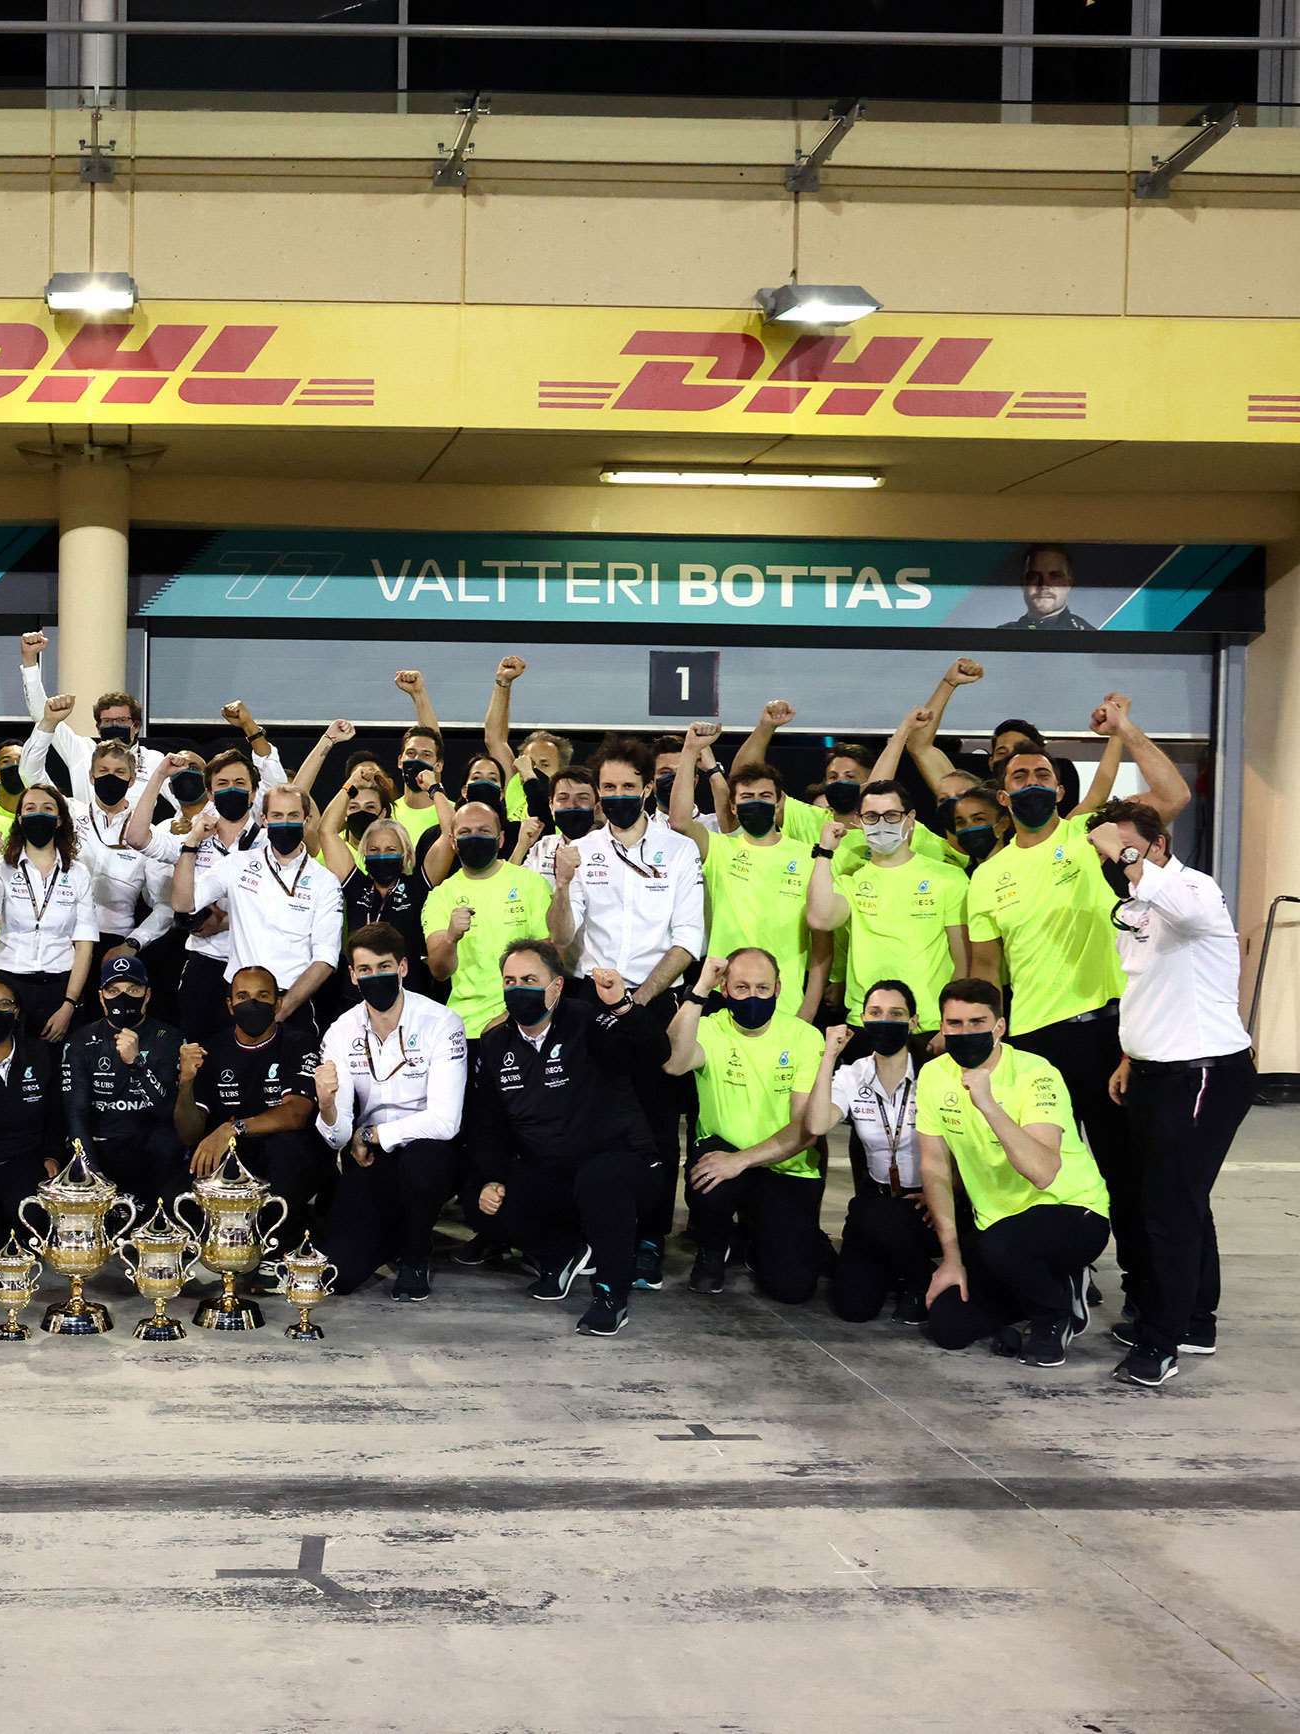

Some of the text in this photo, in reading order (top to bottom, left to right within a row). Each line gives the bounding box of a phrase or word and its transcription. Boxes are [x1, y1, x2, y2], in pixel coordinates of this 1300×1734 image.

[610, 330, 1015, 418] DHL
[218, 550, 933, 610] 77 VALTTERI BOTTAS
[675, 666, 690, 700] 1
[545, 1065, 564, 1075] INEOS
[508, 1073, 522, 1082] UBS
[100, 1080, 115, 1089] UBS
[225, 1090, 240, 1099] UBS
[94, 1100, 154, 1112] ETRONAS
[861, 1107, 876, 1115] UBS
